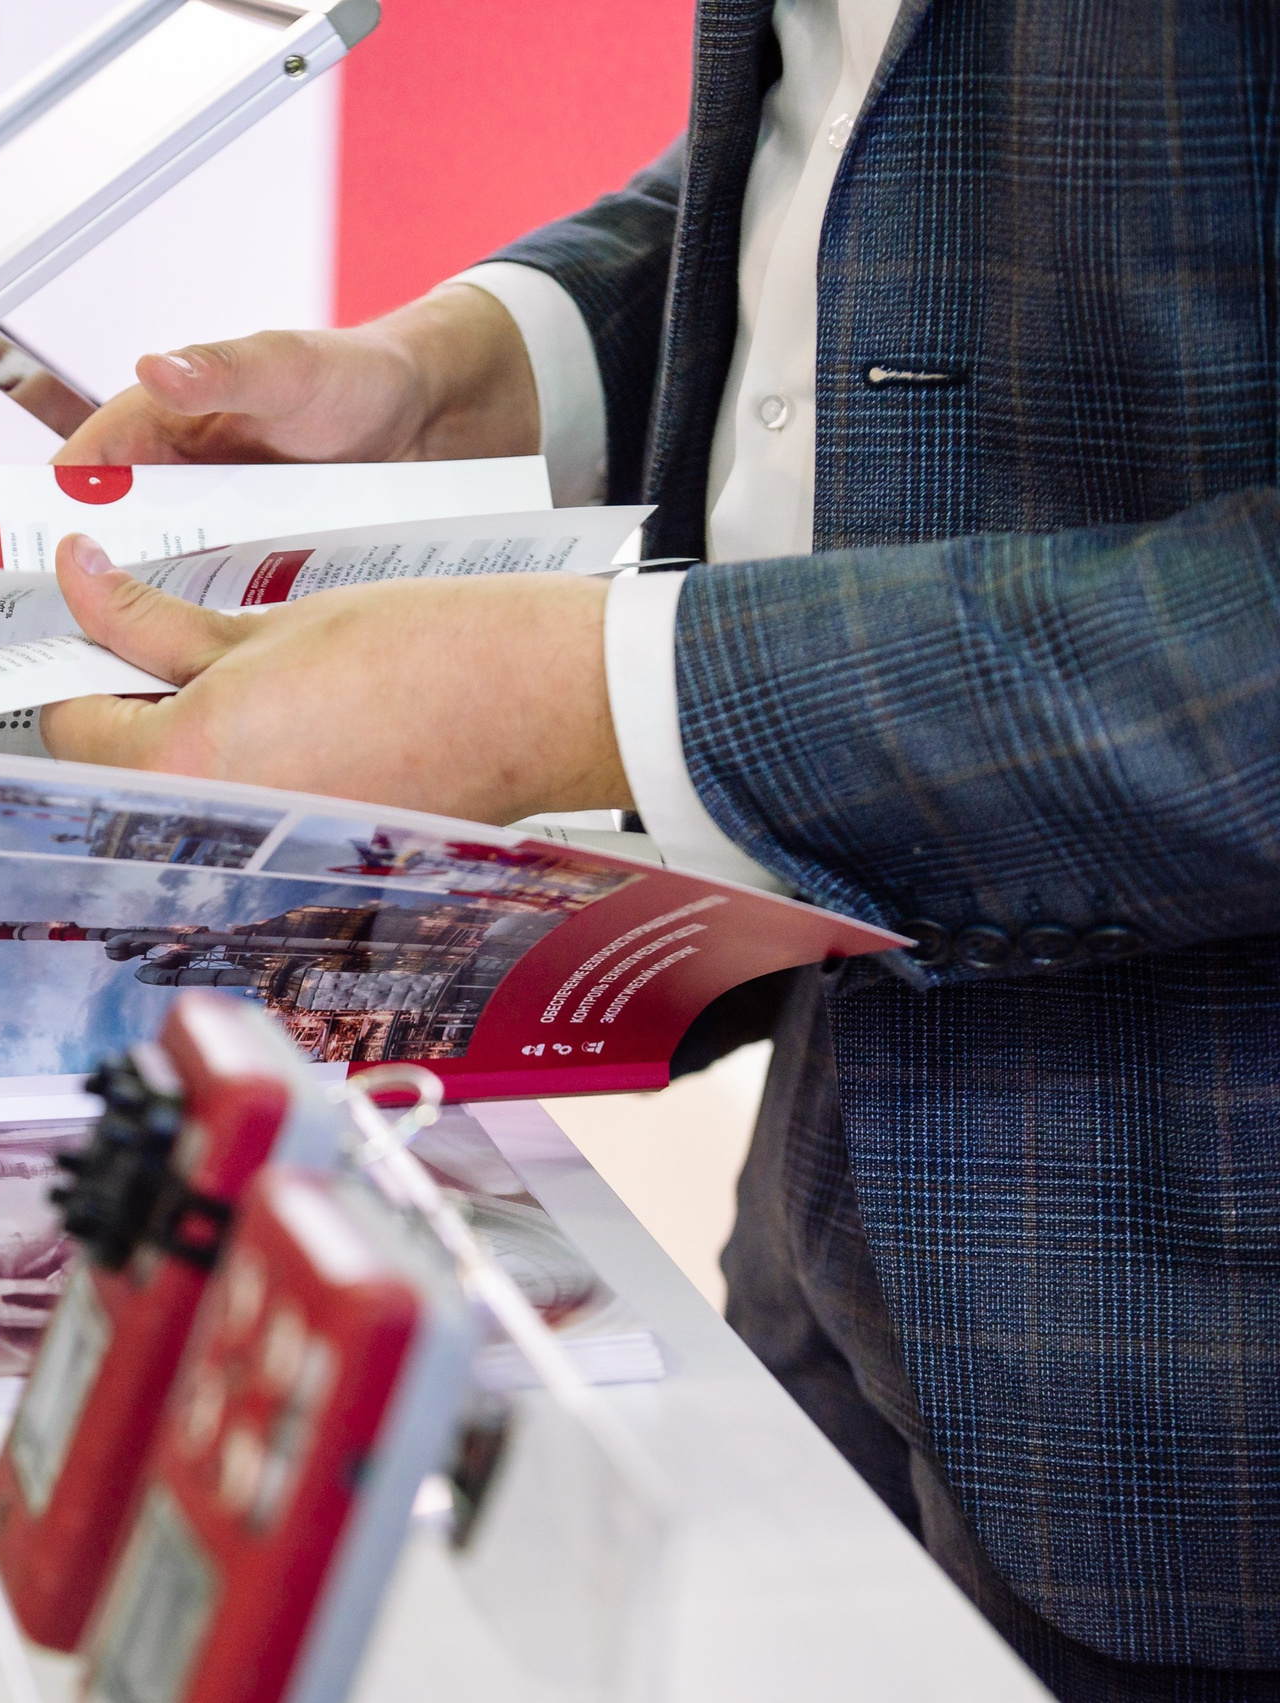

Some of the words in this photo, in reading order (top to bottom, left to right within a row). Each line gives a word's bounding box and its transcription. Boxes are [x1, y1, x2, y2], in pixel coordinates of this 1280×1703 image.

[539, 970, 591, 1024] ОБЕСПЕЧЕНИЕ
[569, 983, 611, 1024] КОНТРОЛЬ
[599, 969, 660, 1024] ЭКОЛОГИЧЕСКИЙ
